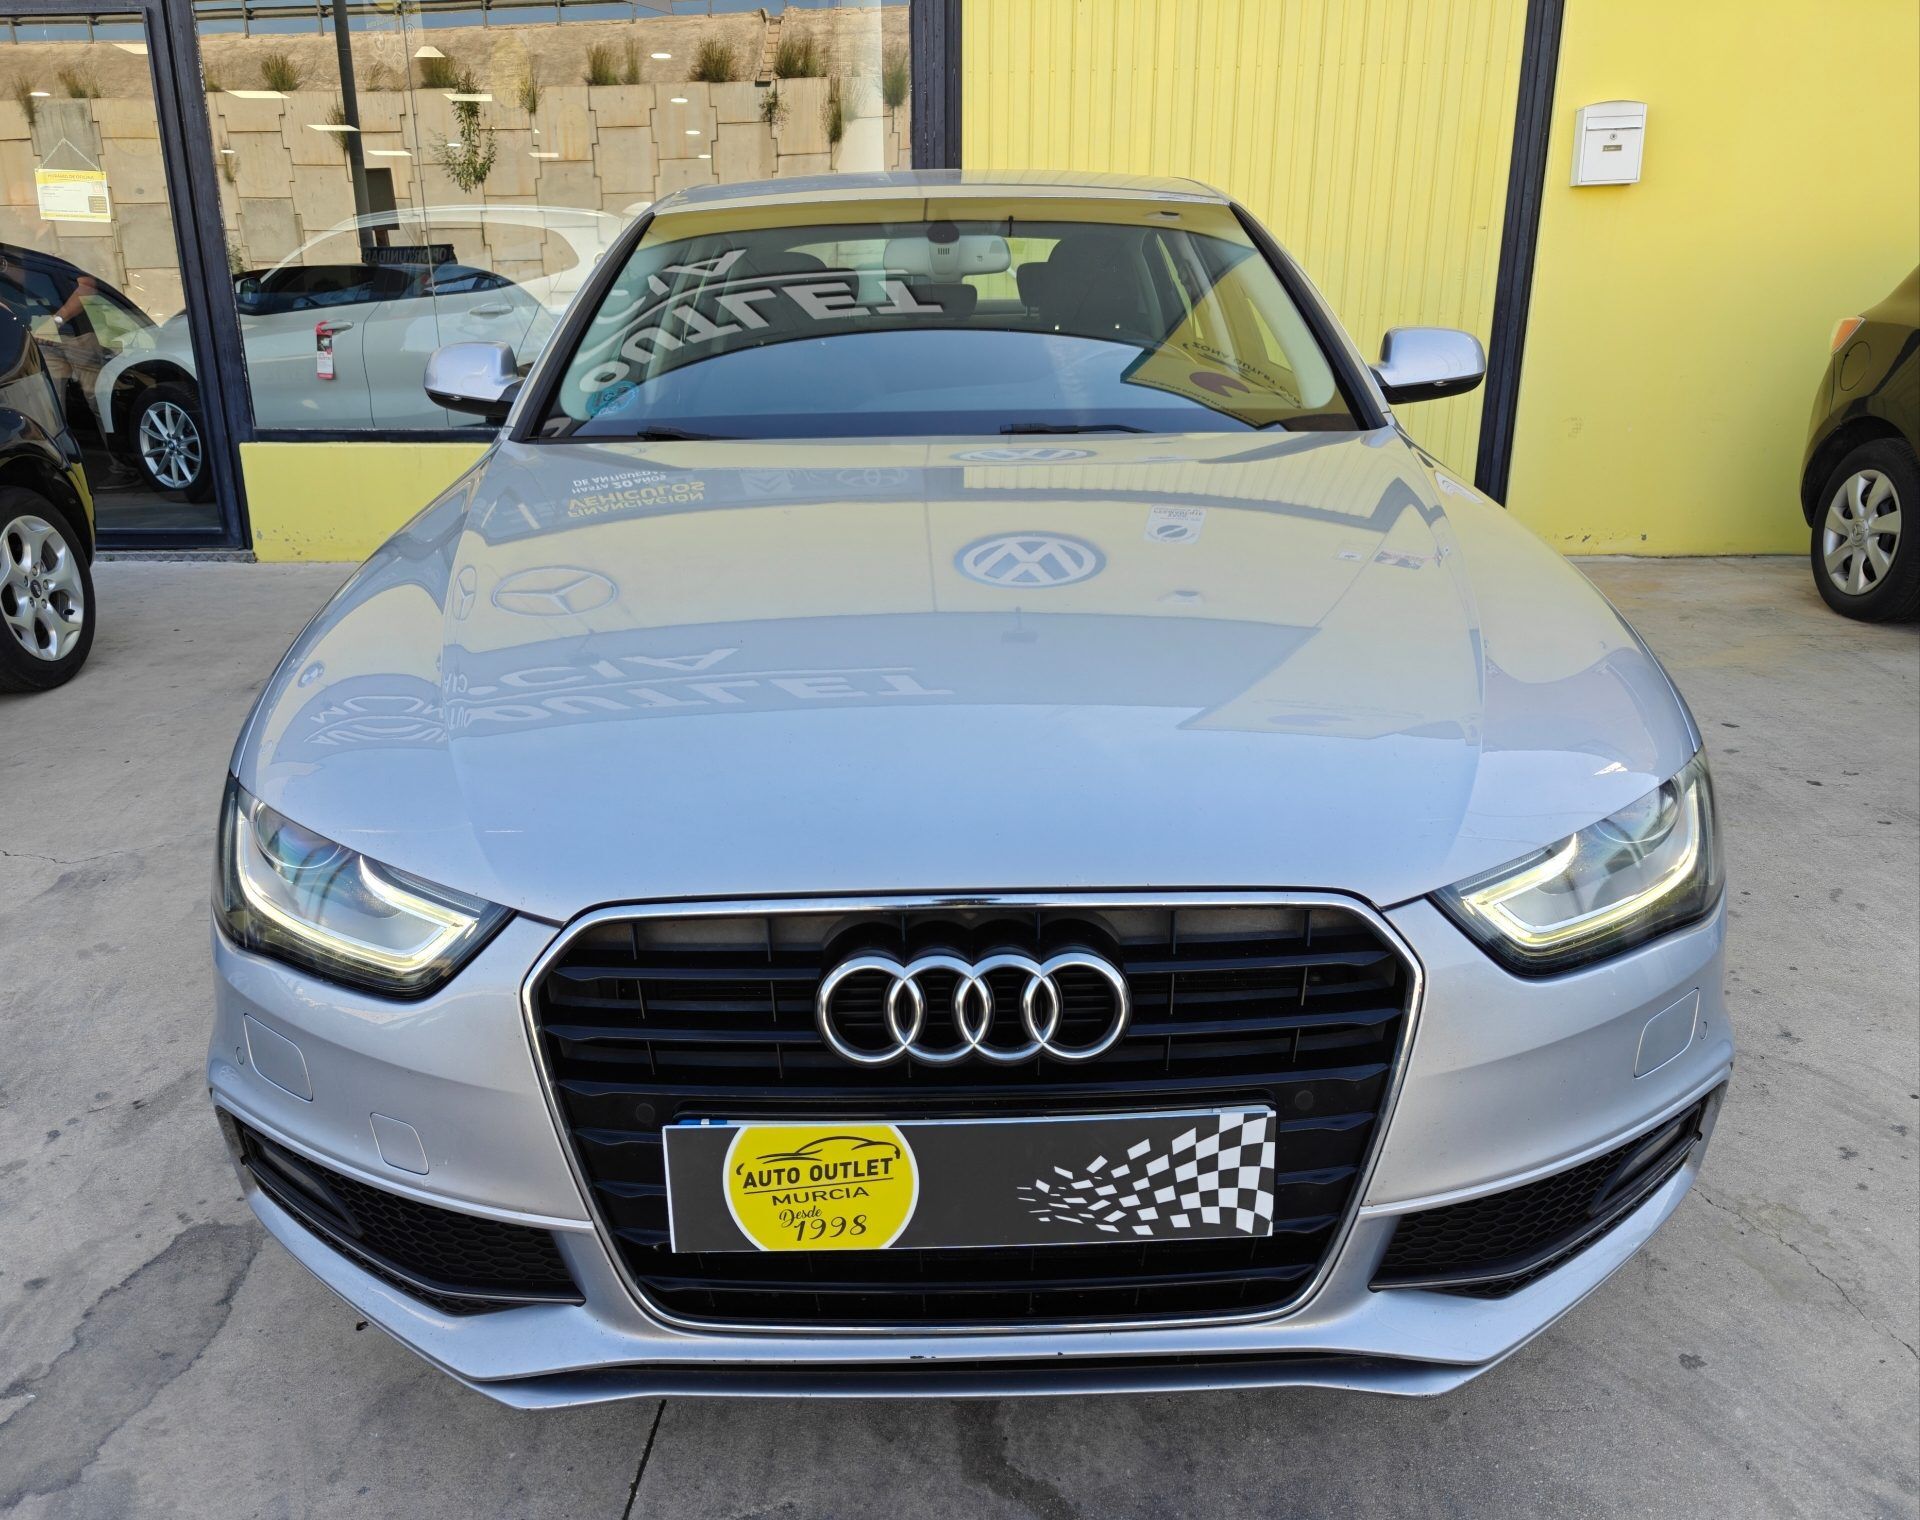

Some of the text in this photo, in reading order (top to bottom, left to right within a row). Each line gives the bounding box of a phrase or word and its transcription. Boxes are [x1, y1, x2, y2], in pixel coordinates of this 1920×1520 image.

[742, 1157, 893, 1190] AUTO OUTLET
[771, 1186, 870, 1207] MURCIA
[778, 1204, 823, 1229] Desde
[793, 1213, 868, 1242] 1998
